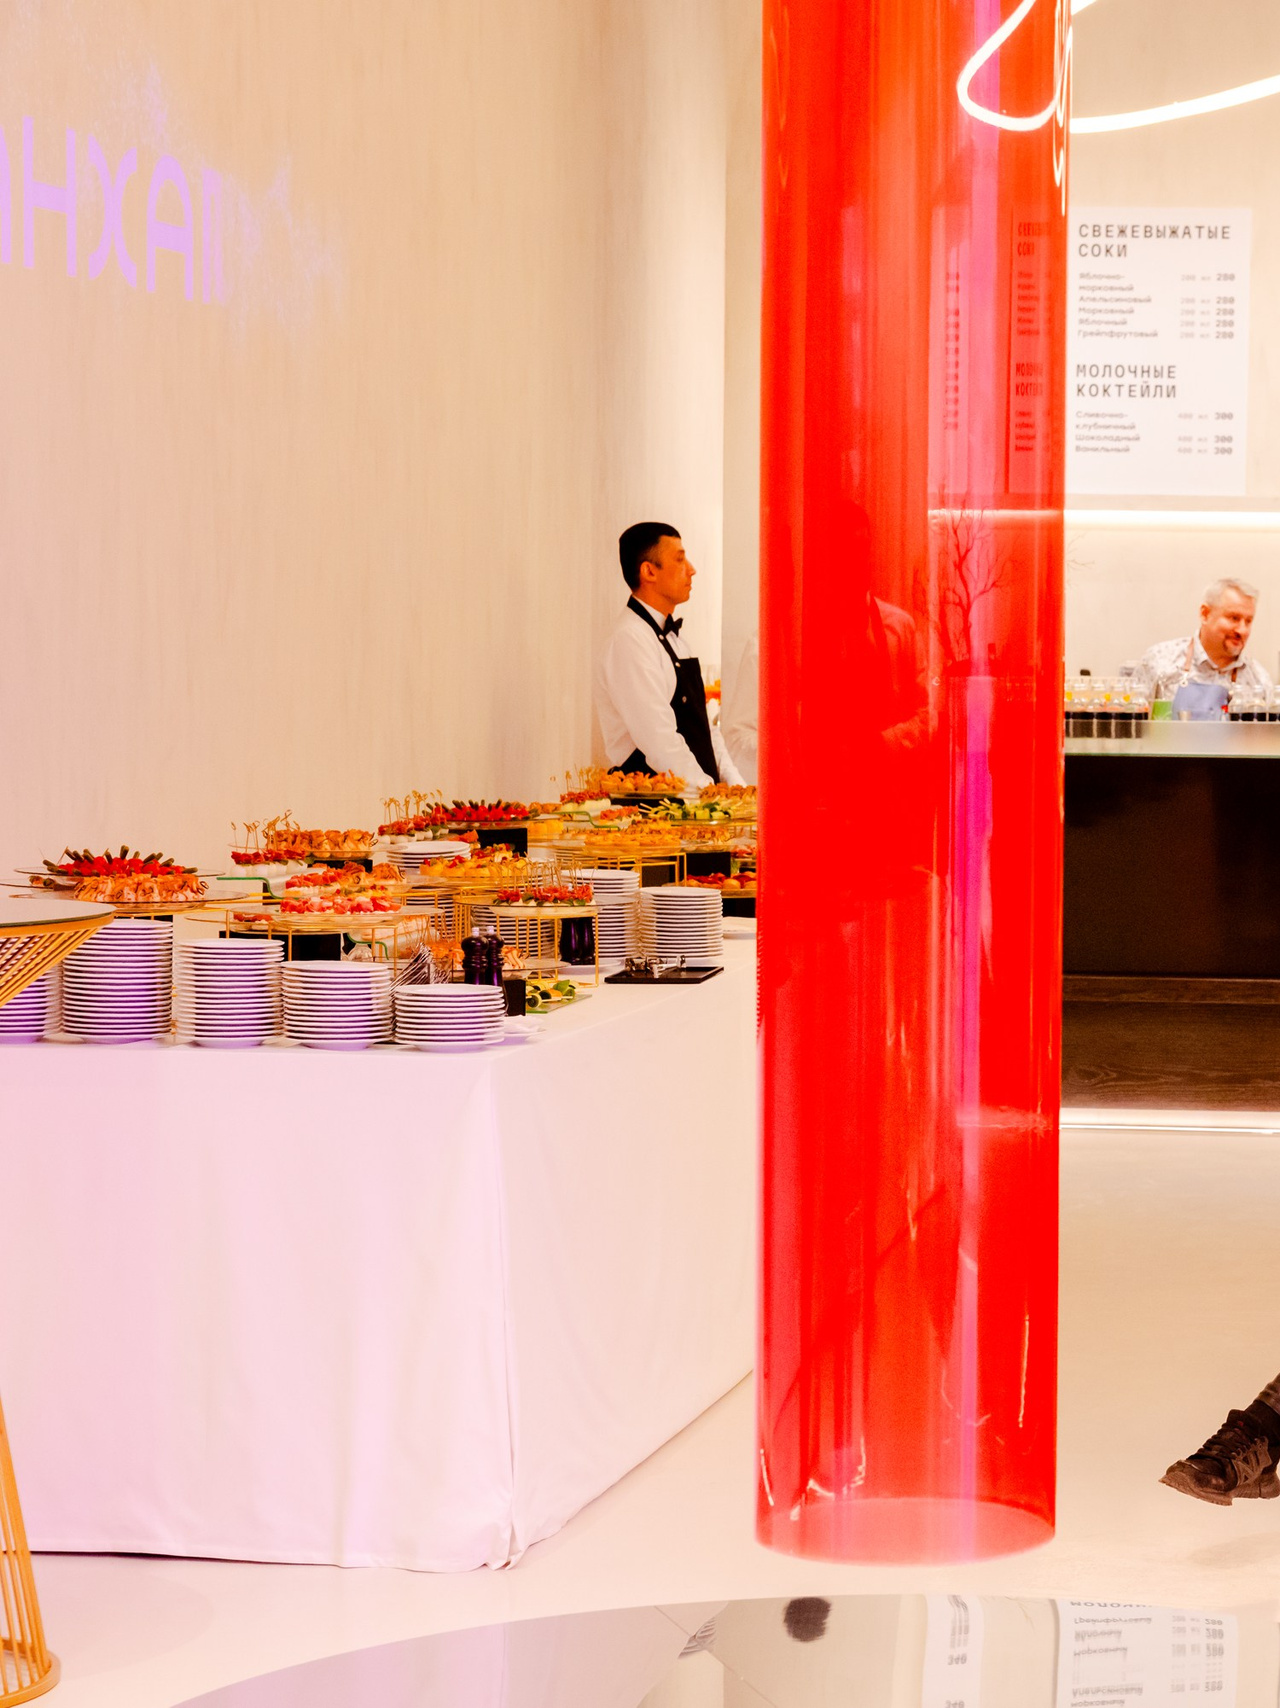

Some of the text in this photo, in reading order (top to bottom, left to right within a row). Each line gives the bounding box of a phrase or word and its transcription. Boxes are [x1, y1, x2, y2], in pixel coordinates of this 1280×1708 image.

[1079, 224, 1230, 240] СВЕЖЕВЫЖАТЫЕ
[1079, 243, 1127, 258] СОКИ
[1216, 273, 1236, 282] 280
[1216, 296, 1235, 305] 280
[1216, 308, 1235, 316] 280
[1215, 319, 1235, 328] 280
[1215, 331, 1234, 339] 280
[1077, 364, 1176, 379] МОЛОЧНЫЕ
[1077, 381, 1176, 398] КОКТЕЙЛИ
[1215, 412, 1234, 420] 300
[1214, 435, 1233, 443] 300
[1214, 446, 1233, 455] 300
